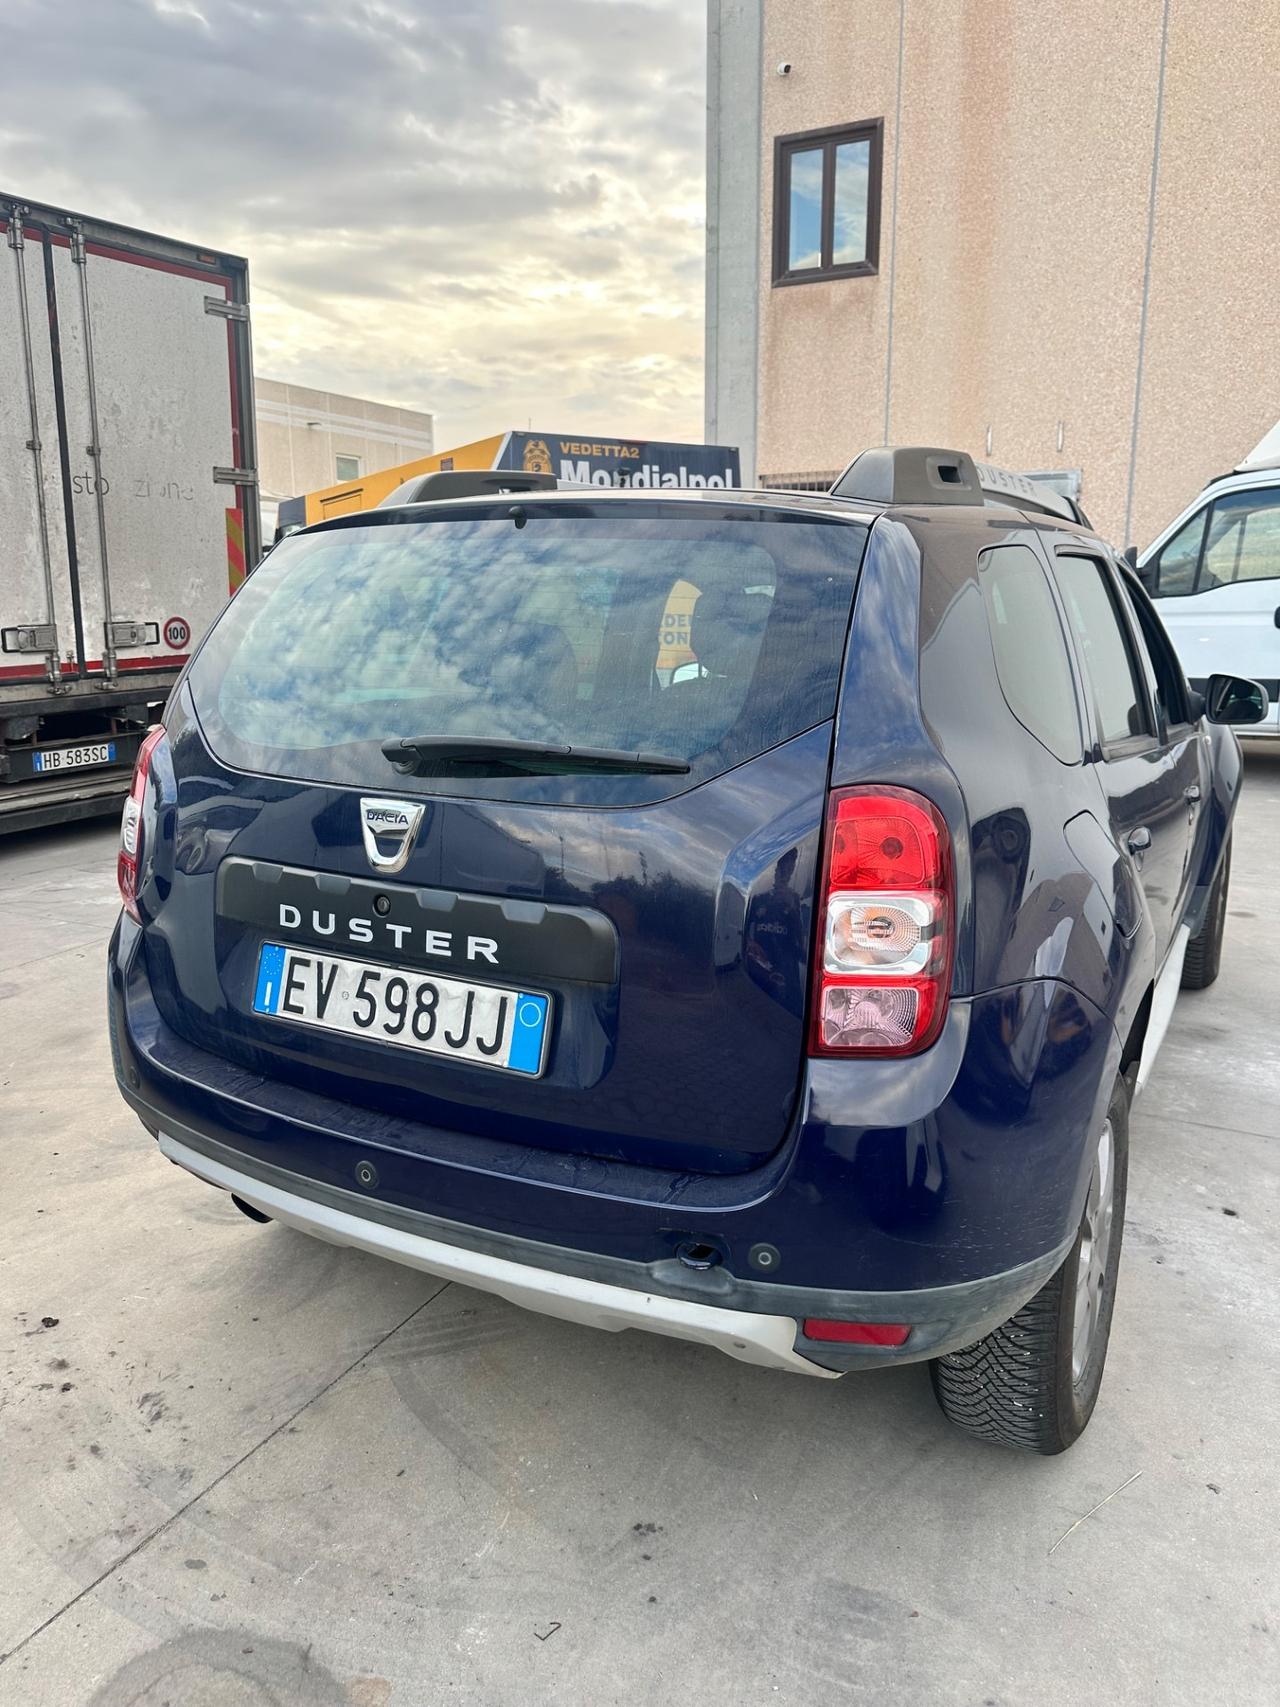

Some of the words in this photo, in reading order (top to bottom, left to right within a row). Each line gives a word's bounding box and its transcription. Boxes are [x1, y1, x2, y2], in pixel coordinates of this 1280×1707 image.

[560, 441, 640, 459] VEDETTA2
[168, 627, 186, 640] 100
[43, 752, 61, 769] HB
[66, 745, 108, 765] 583SC
[366, 811, 409, 825] DACIA
[279, 903, 499, 964] DUSTER
[282, 955, 339, 1020] EV
[352, 972, 508, 1057] 598JJ
